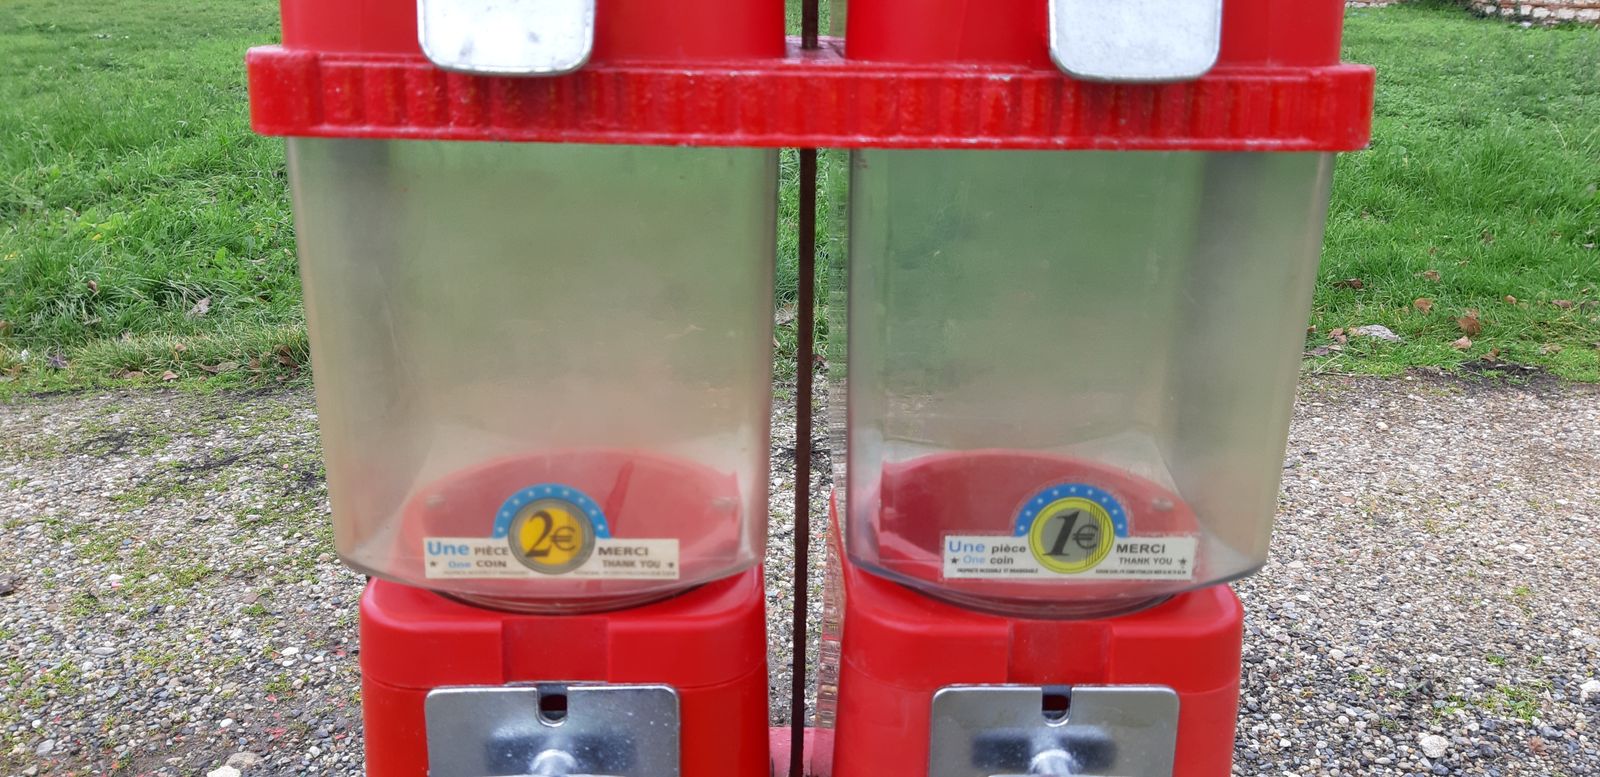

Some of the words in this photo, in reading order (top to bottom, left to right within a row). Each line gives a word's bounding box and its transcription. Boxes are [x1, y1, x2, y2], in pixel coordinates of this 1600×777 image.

[427, 541, 470, 556] Une
[474, 545, 509, 556] PIÈCE
[598, 546, 649, 556] MERCI
[948, 540, 985, 553] Une
[991, 544, 1026, 556] pièce
[1116, 544, 1166, 554] MERCI
[448, 560, 471, 569] One
[476, 559, 507, 568] COIN
[602, 560, 636, 568] THANK
[640, 560, 661, 569] YOU
[963, 556, 985, 564] One
[990, 556, 1014, 565] coin
[1119, 557, 1151, 565] THANK
[1154, 557, 1173, 565] YOU
